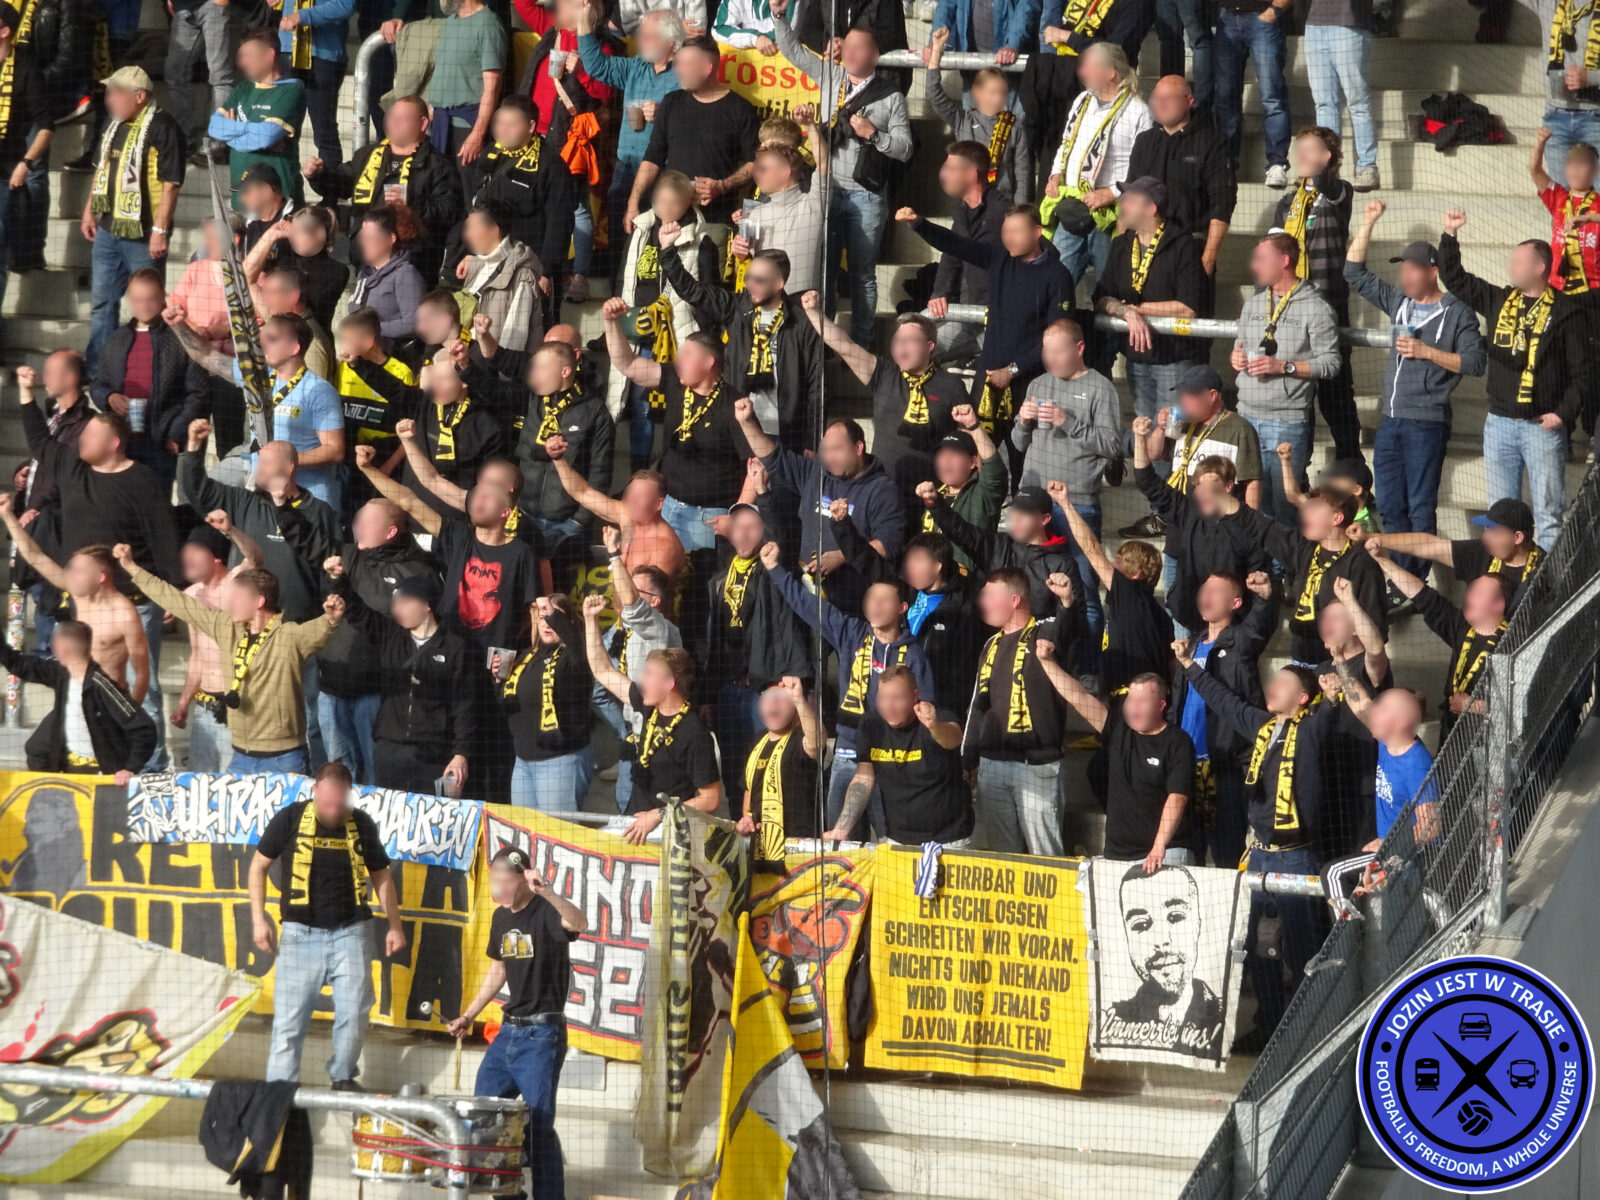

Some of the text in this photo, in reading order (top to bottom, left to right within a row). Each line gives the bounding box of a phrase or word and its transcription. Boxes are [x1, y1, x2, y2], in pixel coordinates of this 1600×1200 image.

[1024, 871, 1058, 899] UND
[919, 893, 1049, 930] ENTSCHLOSSEN
[885, 920, 1078, 965] SCHREITEN WIR VORAN.
[889, 952, 1071, 993] NICHTS UND NIEMAND
[907, 984, 1051, 1023] WIRD UNS JEMALS
[902, 1014, 1052, 1053] DAVON ABHALTEN!
